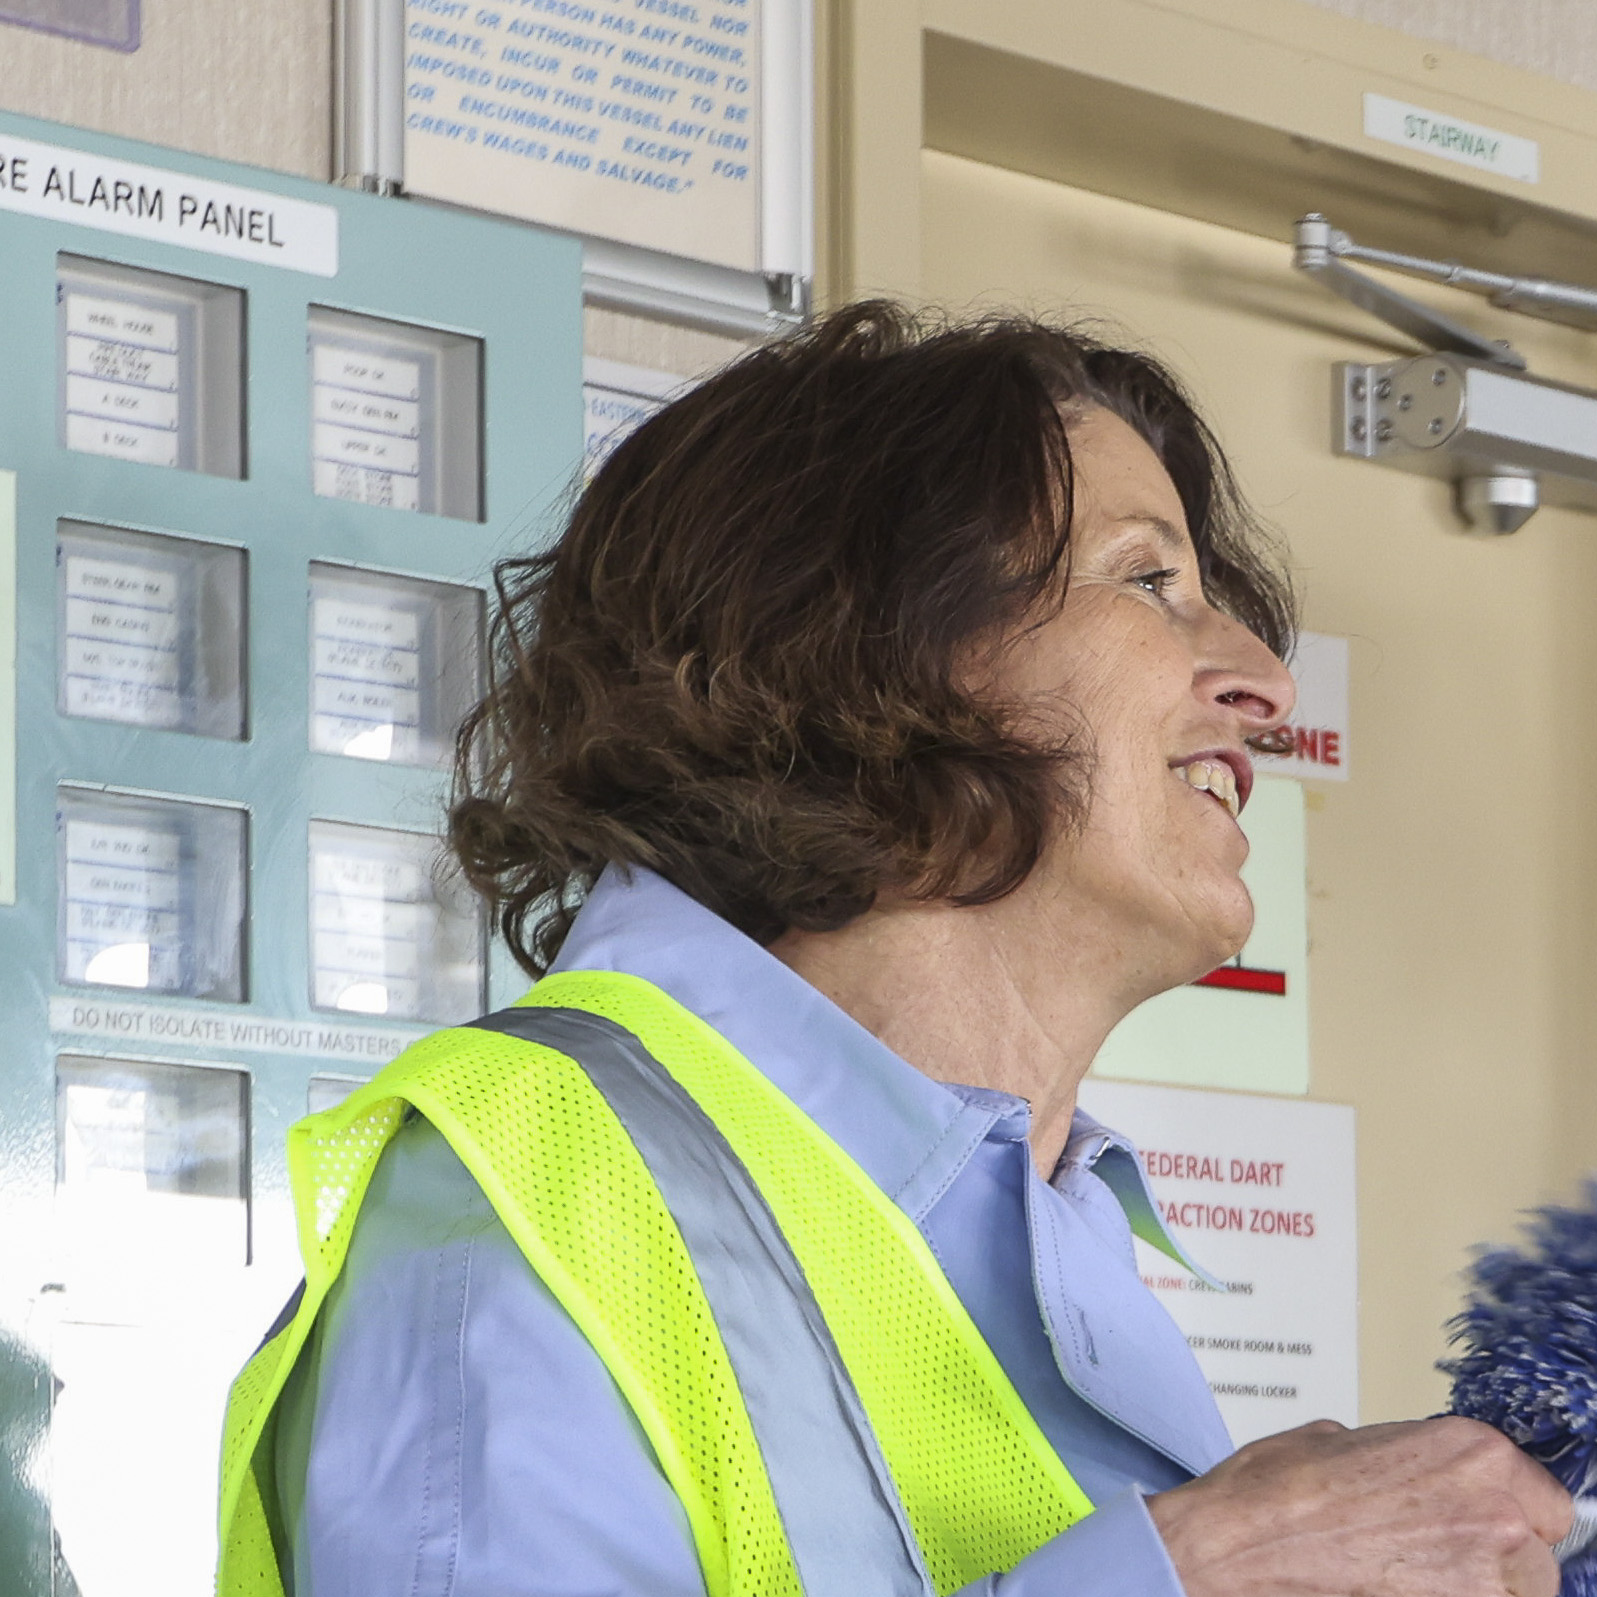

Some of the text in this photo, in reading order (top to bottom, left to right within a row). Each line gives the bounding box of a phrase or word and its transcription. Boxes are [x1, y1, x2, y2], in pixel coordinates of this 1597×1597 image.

[710, 13, 749, 36] NOR
[408, 22, 750, 123] CREATE, INCUR OR PERMIT TO BE
[507, 18, 617, 58] AUTHORITY
[621, 47, 719, 87] WHATEVER
[725, 74, 748, 94] TO
[406, 52, 749, 153] IMPOSED UPON THIS VESSEL ANY LIEN
[406, 82, 749, 182] OR ENCUMBRANCE EXCEPT FOR
[482, 130, 550, 162] WAGES
[552, 148, 591, 173] AND
[1403, 113, 1499, 162] STAIRWAY
[43, 166, 164, 222] ALARM
[178, 194, 285, 249] PANEL
[1262, 724, 1341, 767] ONE
[72, 1007, 100, 1027] DO
[105, 1012, 144, 1034] NOT
[150, 1013, 226, 1042] ISOLATE
[230, 1021, 314, 1050] WITHOUT
[317, 1030, 401, 1056] MASTERS
[1140, 1150, 1285, 1187] EDERAL DART
[1158, 1199, 1316, 1238] ACTION ZONES
[1219, 1280, 1254, 1295] ABINS
[1207, 1336, 1241, 1350] SMOKE
[1243, 1338, 1275, 1352] ROOM
[1276, 1341, 1284, 1354] &
[1286, 1342, 1313, 1356] MESS
[1260, 1386, 1298, 1399] LOCKER
